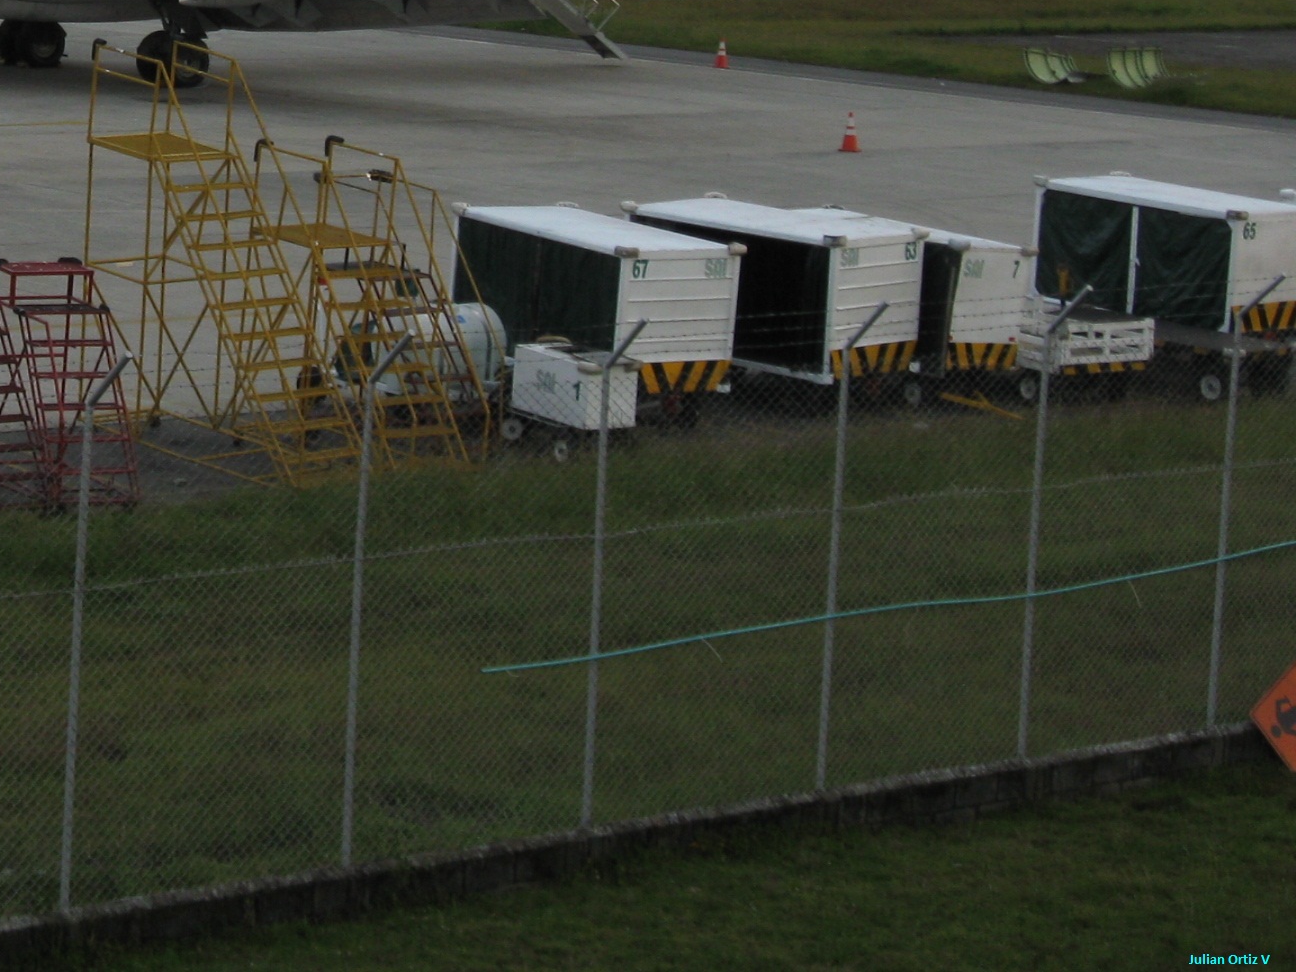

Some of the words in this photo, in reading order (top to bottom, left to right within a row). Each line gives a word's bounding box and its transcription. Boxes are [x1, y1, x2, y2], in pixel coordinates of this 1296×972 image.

[1243, 222, 1257, 240] 65
[632, 259, 649, 279] 67
[1012, 260, 1020, 279] 7
[573, 380, 581, 401] 1
